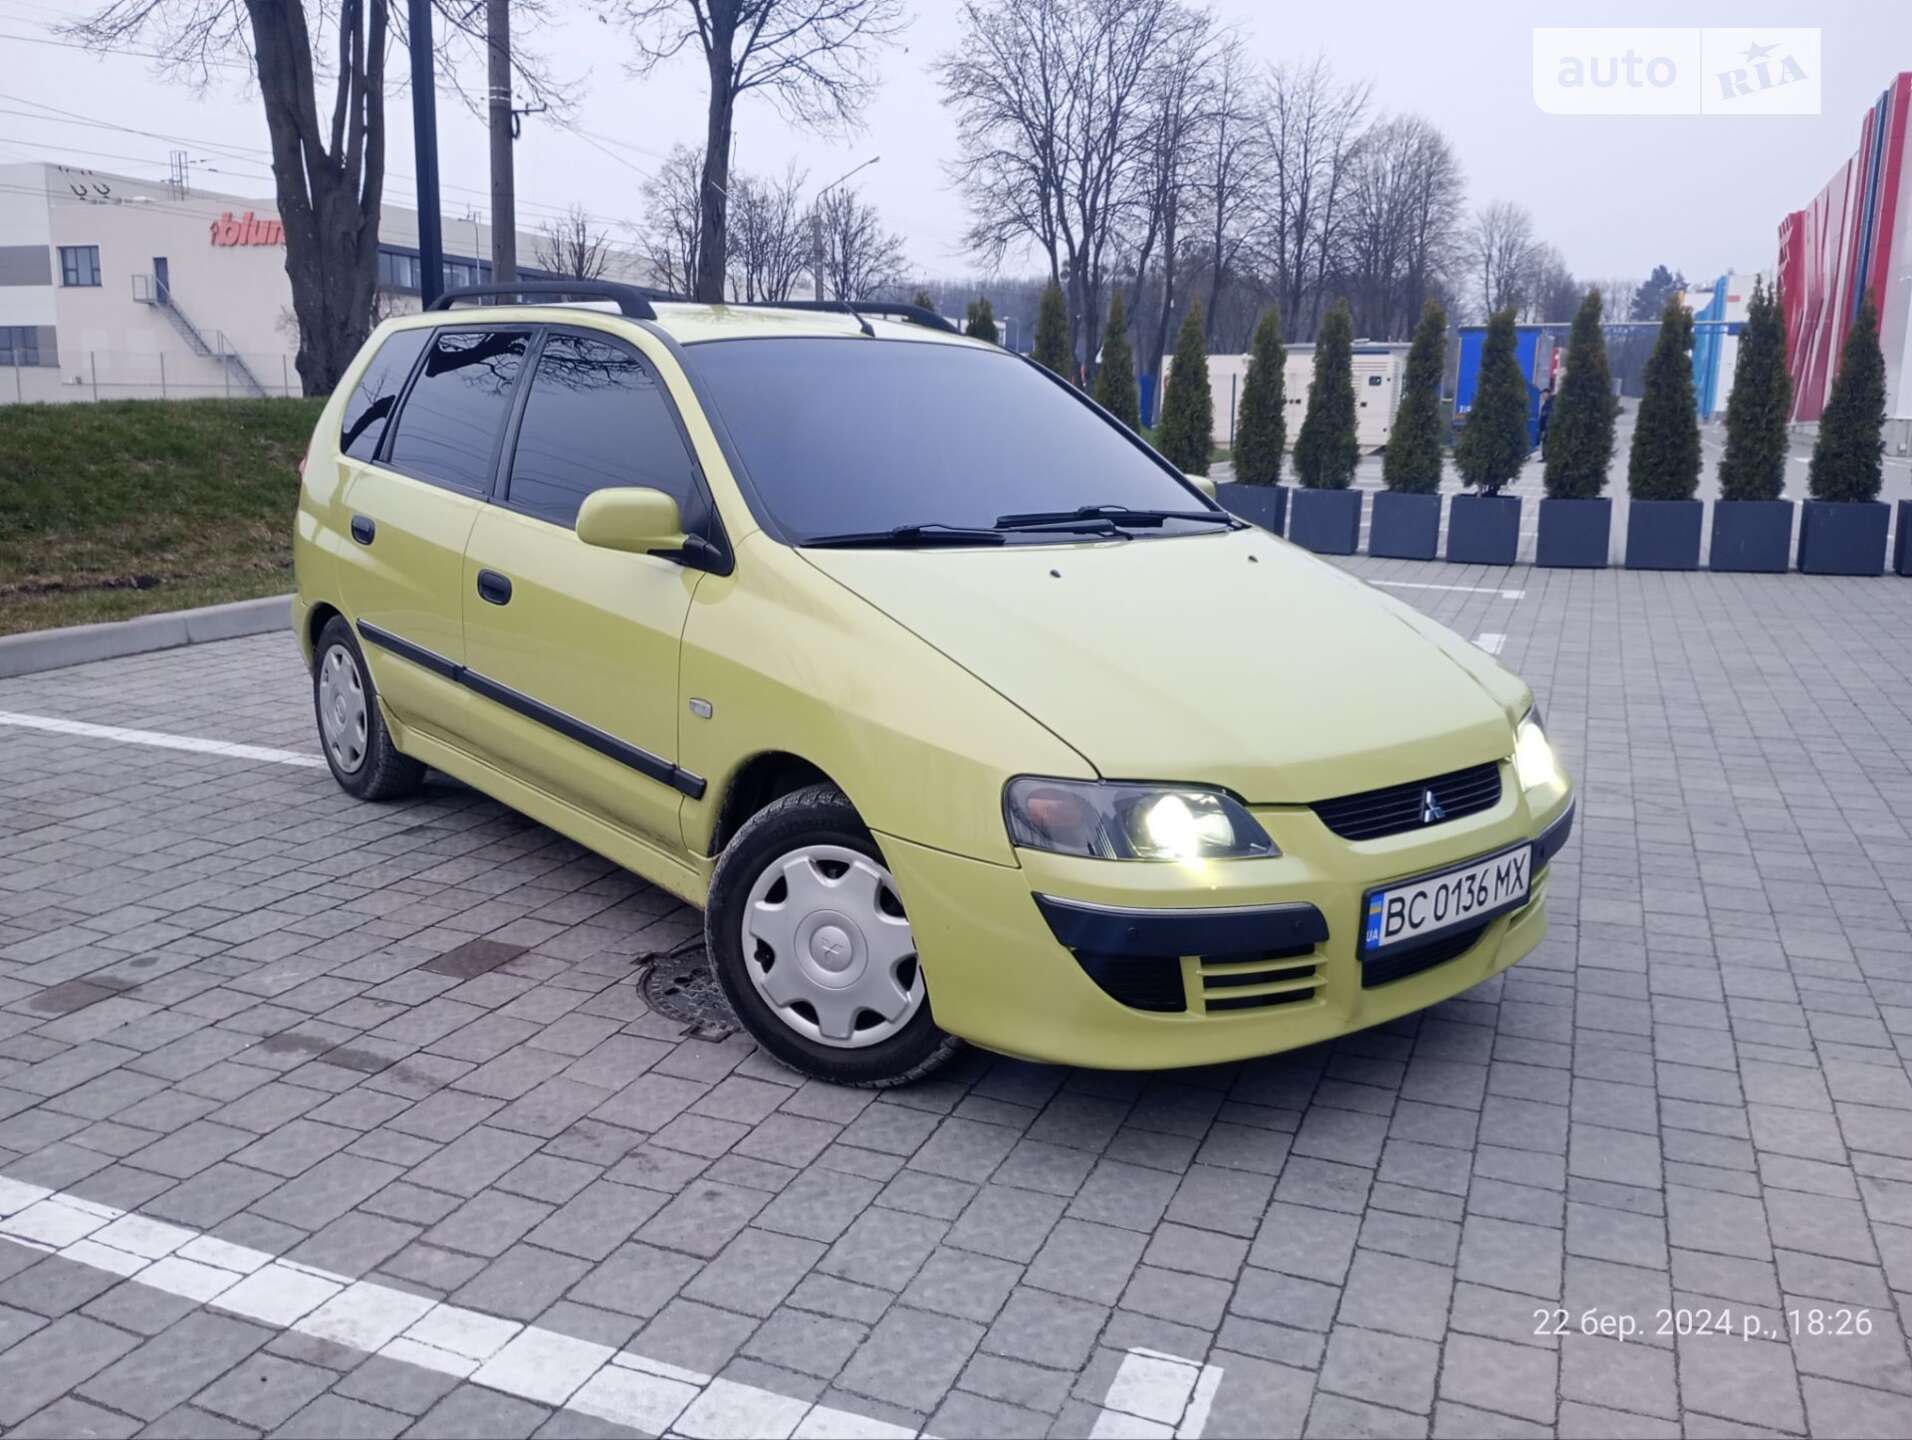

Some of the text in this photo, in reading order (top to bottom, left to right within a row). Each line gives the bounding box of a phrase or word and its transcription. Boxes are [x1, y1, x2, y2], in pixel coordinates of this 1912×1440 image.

[1384, 852, 1527, 938] BC 0136 MX
[1366, 928, 1378, 942] UA
